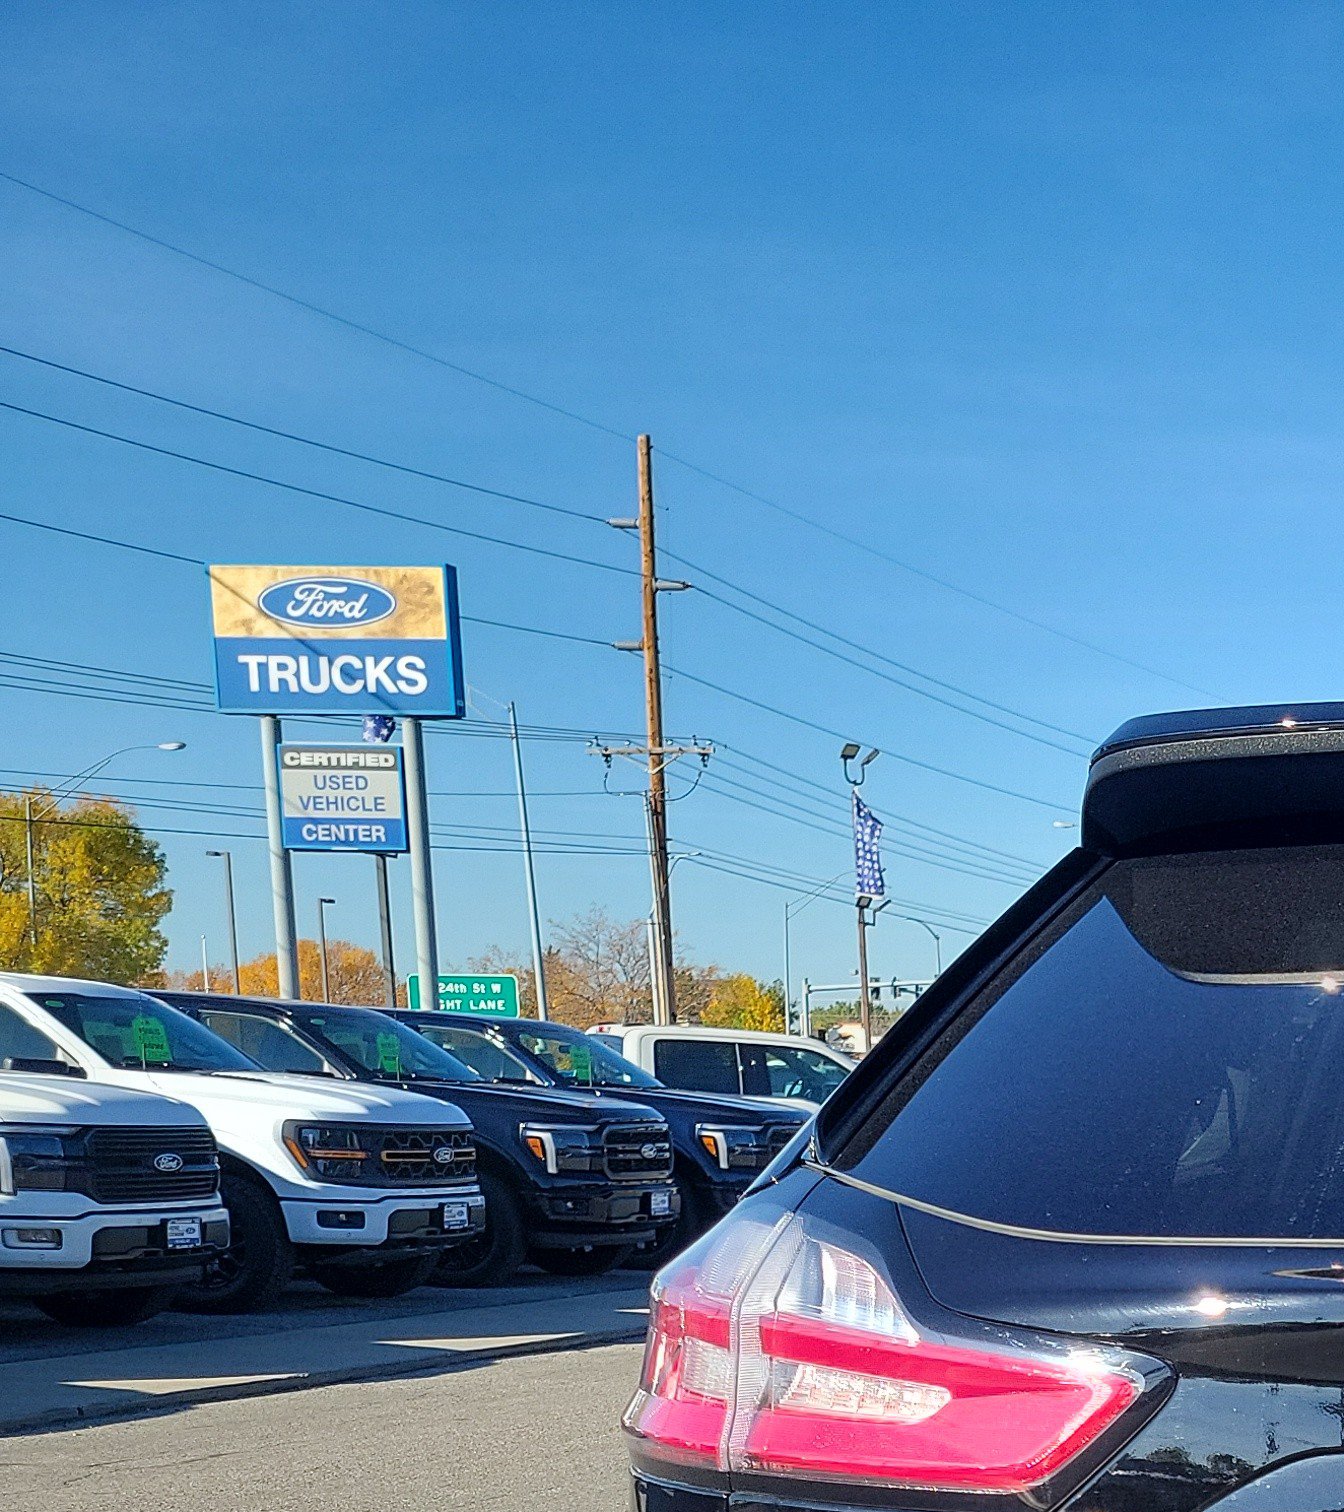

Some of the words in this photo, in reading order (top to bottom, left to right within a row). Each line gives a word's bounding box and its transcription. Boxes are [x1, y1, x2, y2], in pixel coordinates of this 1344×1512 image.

[286, 584, 368, 619] Ford
[237, 655, 428, 695] TRUCKS
[283, 752, 395, 767] CERTIFIED
[313, 775, 368, 791] USED
[299, 796, 386, 812] VEHICLE
[302, 824, 386, 842] CENTER
[438, 983, 467, 994] 24th
[472, 983, 486, 994] St
[490, 983, 501, 994] W
[469, 1000, 506, 1010] LANE
